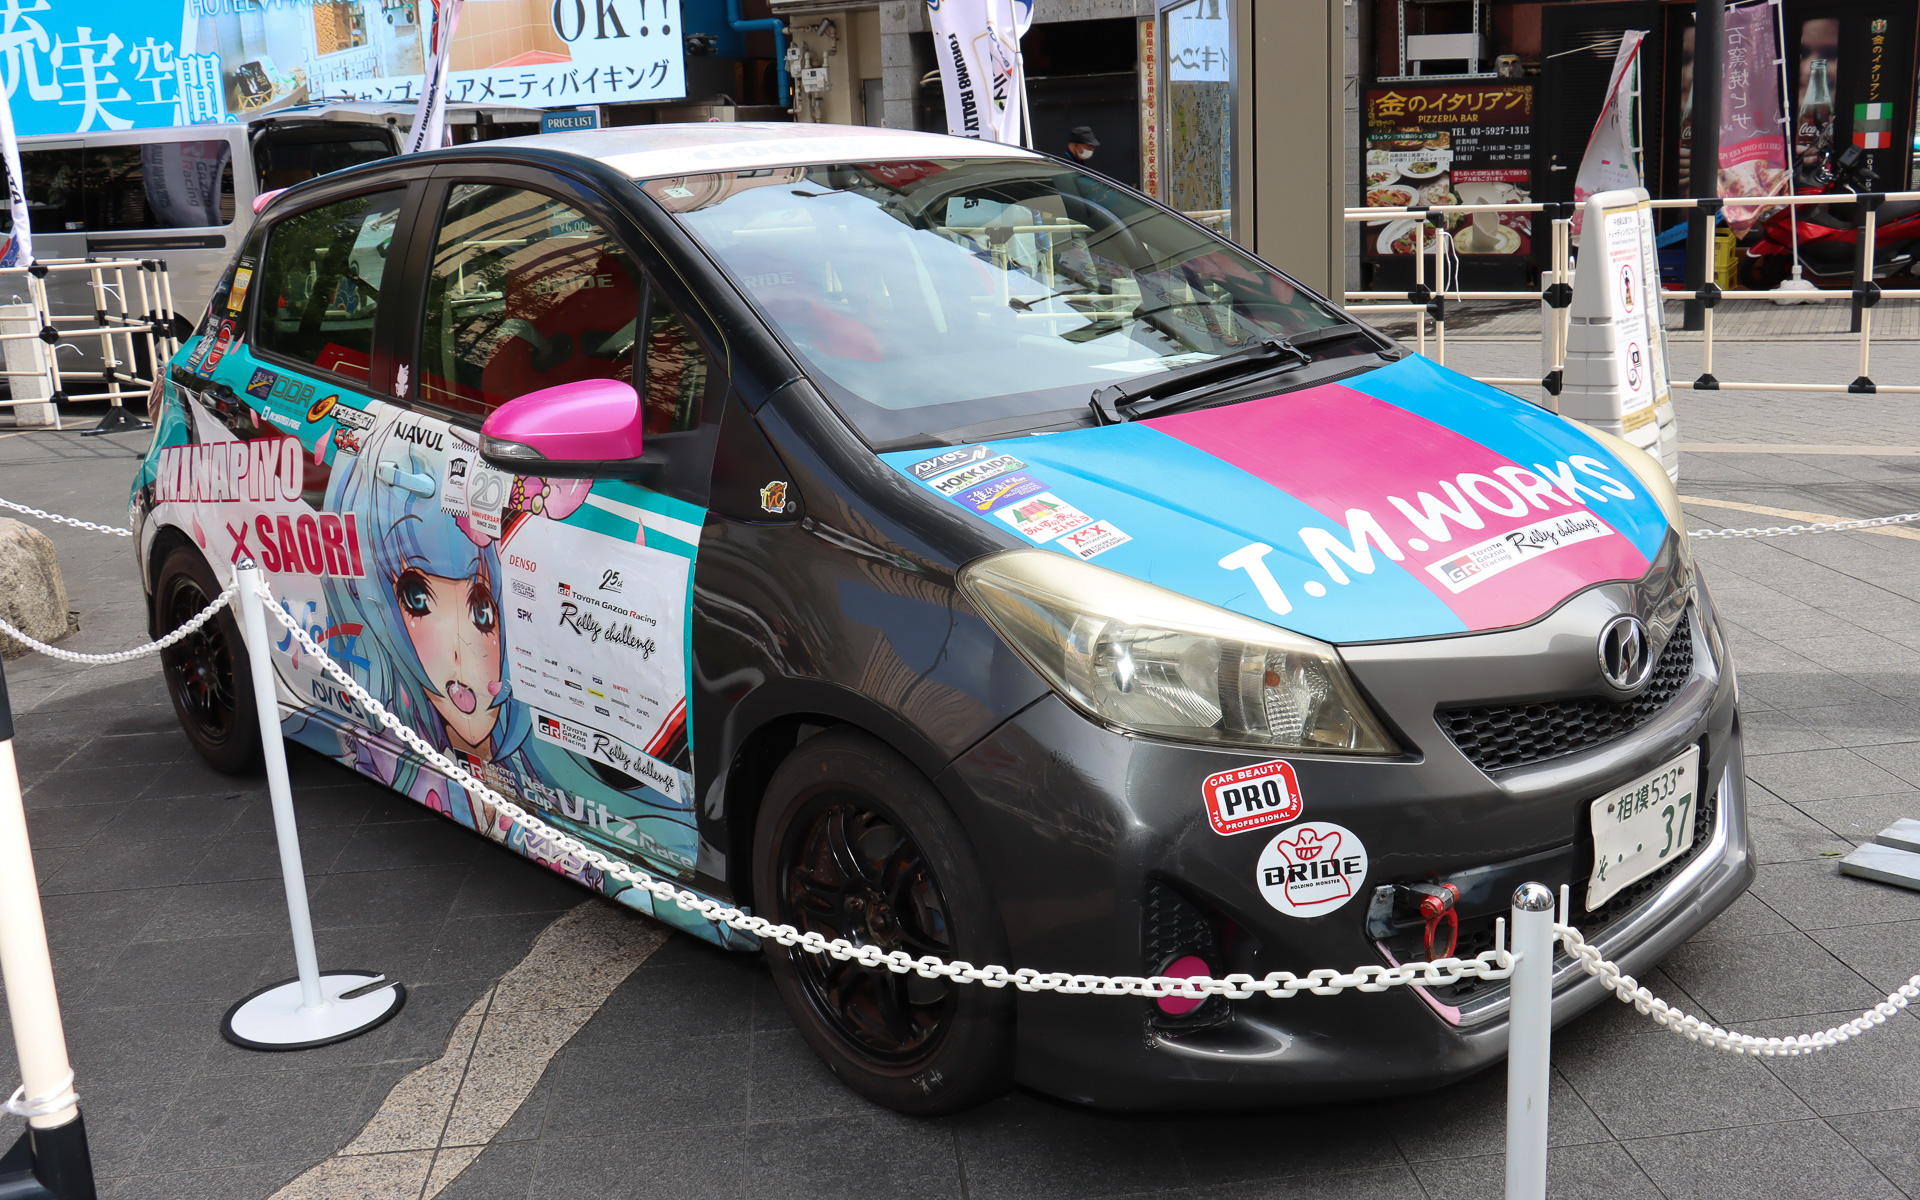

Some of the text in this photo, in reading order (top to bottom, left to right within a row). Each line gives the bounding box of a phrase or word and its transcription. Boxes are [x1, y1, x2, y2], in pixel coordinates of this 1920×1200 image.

[553, 0, 672, 42] OK!!
[948, 33, 980, 131] FORUM8 RALLY
[1870, 35, 1885, 101] 金のイタリアン
[1375, 91, 1524, 118] 金のイタリアン
[1418, 113, 1479, 124] PIZZERIA BAR
[547, 116, 593, 129] PRICE LIST
[1452, 126, 1530, 136] TEL 03-5927-1313
[182, 160, 200, 207] Racing
[394, 421, 444, 452] NAVUL
[155, 434, 304, 503] MINAPIYO
[935, 455, 1015, 492] HOKKAIDO
[470, 472, 503, 513] 20
[254, 513, 366, 578] SAORI
[1217, 455, 1636, 616] T.M.WORKS
[1470, 542, 1503, 558] TOYOTA
[1505, 517, 1599, 554] Rally challenge
[509, 554, 537, 573] DENSO
[1475, 549, 1506, 564] GAZOO
[1481, 553, 1513, 570] Racing
[517, 607, 533, 624] SPK
[558, 586, 657, 627] GR TOYOTA GAZOO Racing
[558, 601, 656, 660] Rally challenge
[539, 723, 561, 740] GR
[561, 724, 588, 738] TOYOTA
[562, 729, 587, 743] GAZOO
[562, 735, 587, 751] Racing
[483, 761, 516, 780] TOYOTA
[592, 733, 675, 794] Rally challenge
[1210, 764, 1283, 787] CAR BEAUTY
[521, 774, 557, 799] Netz
[523, 787, 553, 811] Cup
[1222, 780, 1281, 816] PRO
[1616, 769, 1677, 823] 相模 533
[556, 788, 639, 846] Vitz
[1212, 792, 1298, 831] THE PROFESSIONAL WAY
[1658, 791, 1693, 858] 37
[639, 832, 695, 869] Race
[1263, 855, 1363, 887] BRIDE
[1290, 878, 1341, 891] HOLDING MONSTER
